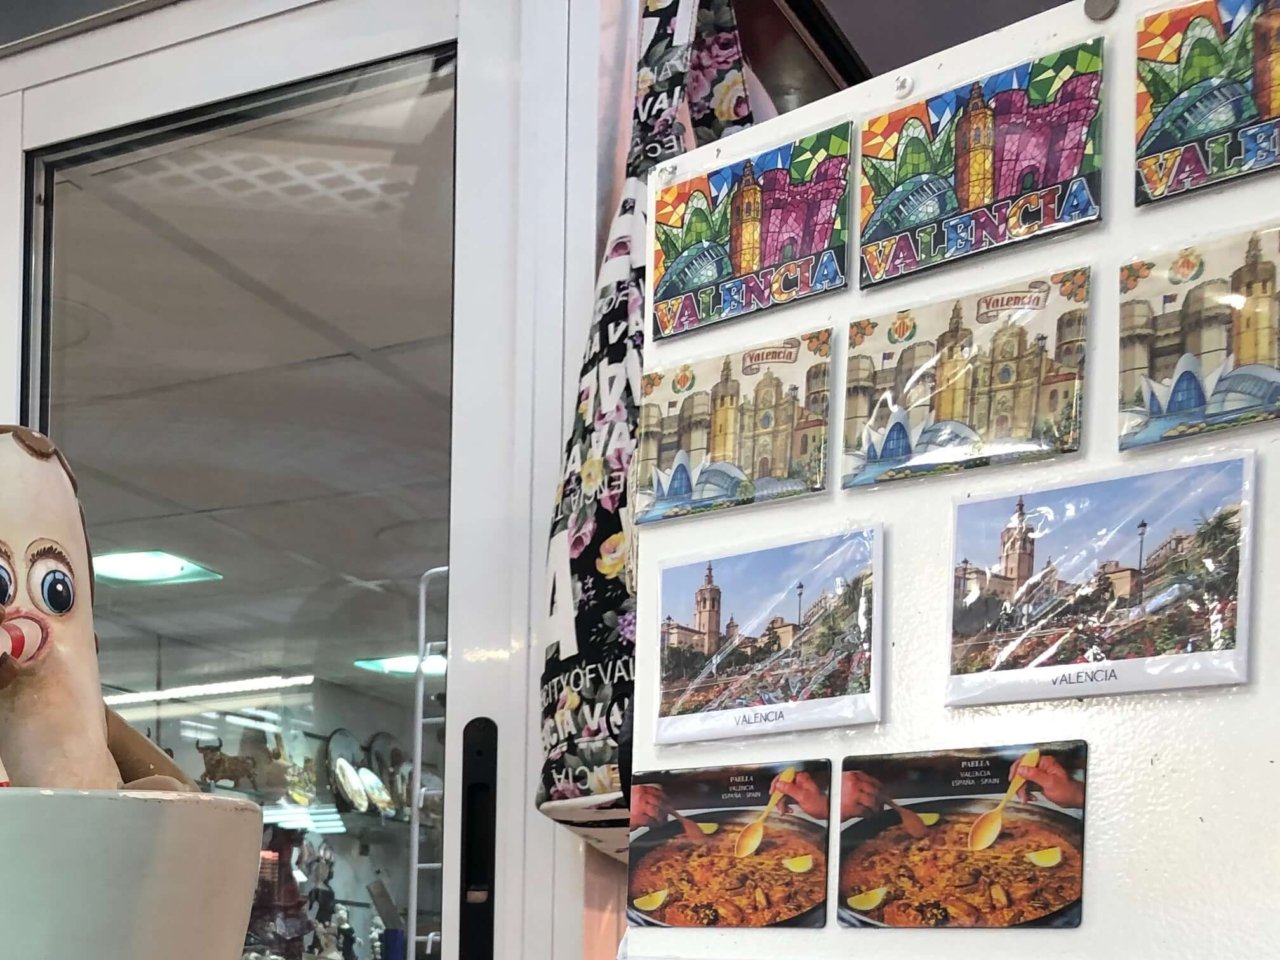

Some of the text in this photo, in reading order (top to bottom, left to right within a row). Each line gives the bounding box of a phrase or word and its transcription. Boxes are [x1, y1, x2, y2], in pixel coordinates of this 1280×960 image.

[1136, 117, 1280, 200] VALE
[861, 178, 1100, 282] VALENCIA
[653, 250, 845, 336] VALENCIA
[1051, 669, 1118, 686] VALENCIA
[734, 710, 785, 726] VALENCIA
[961, 760, 991, 768] PAELLA
